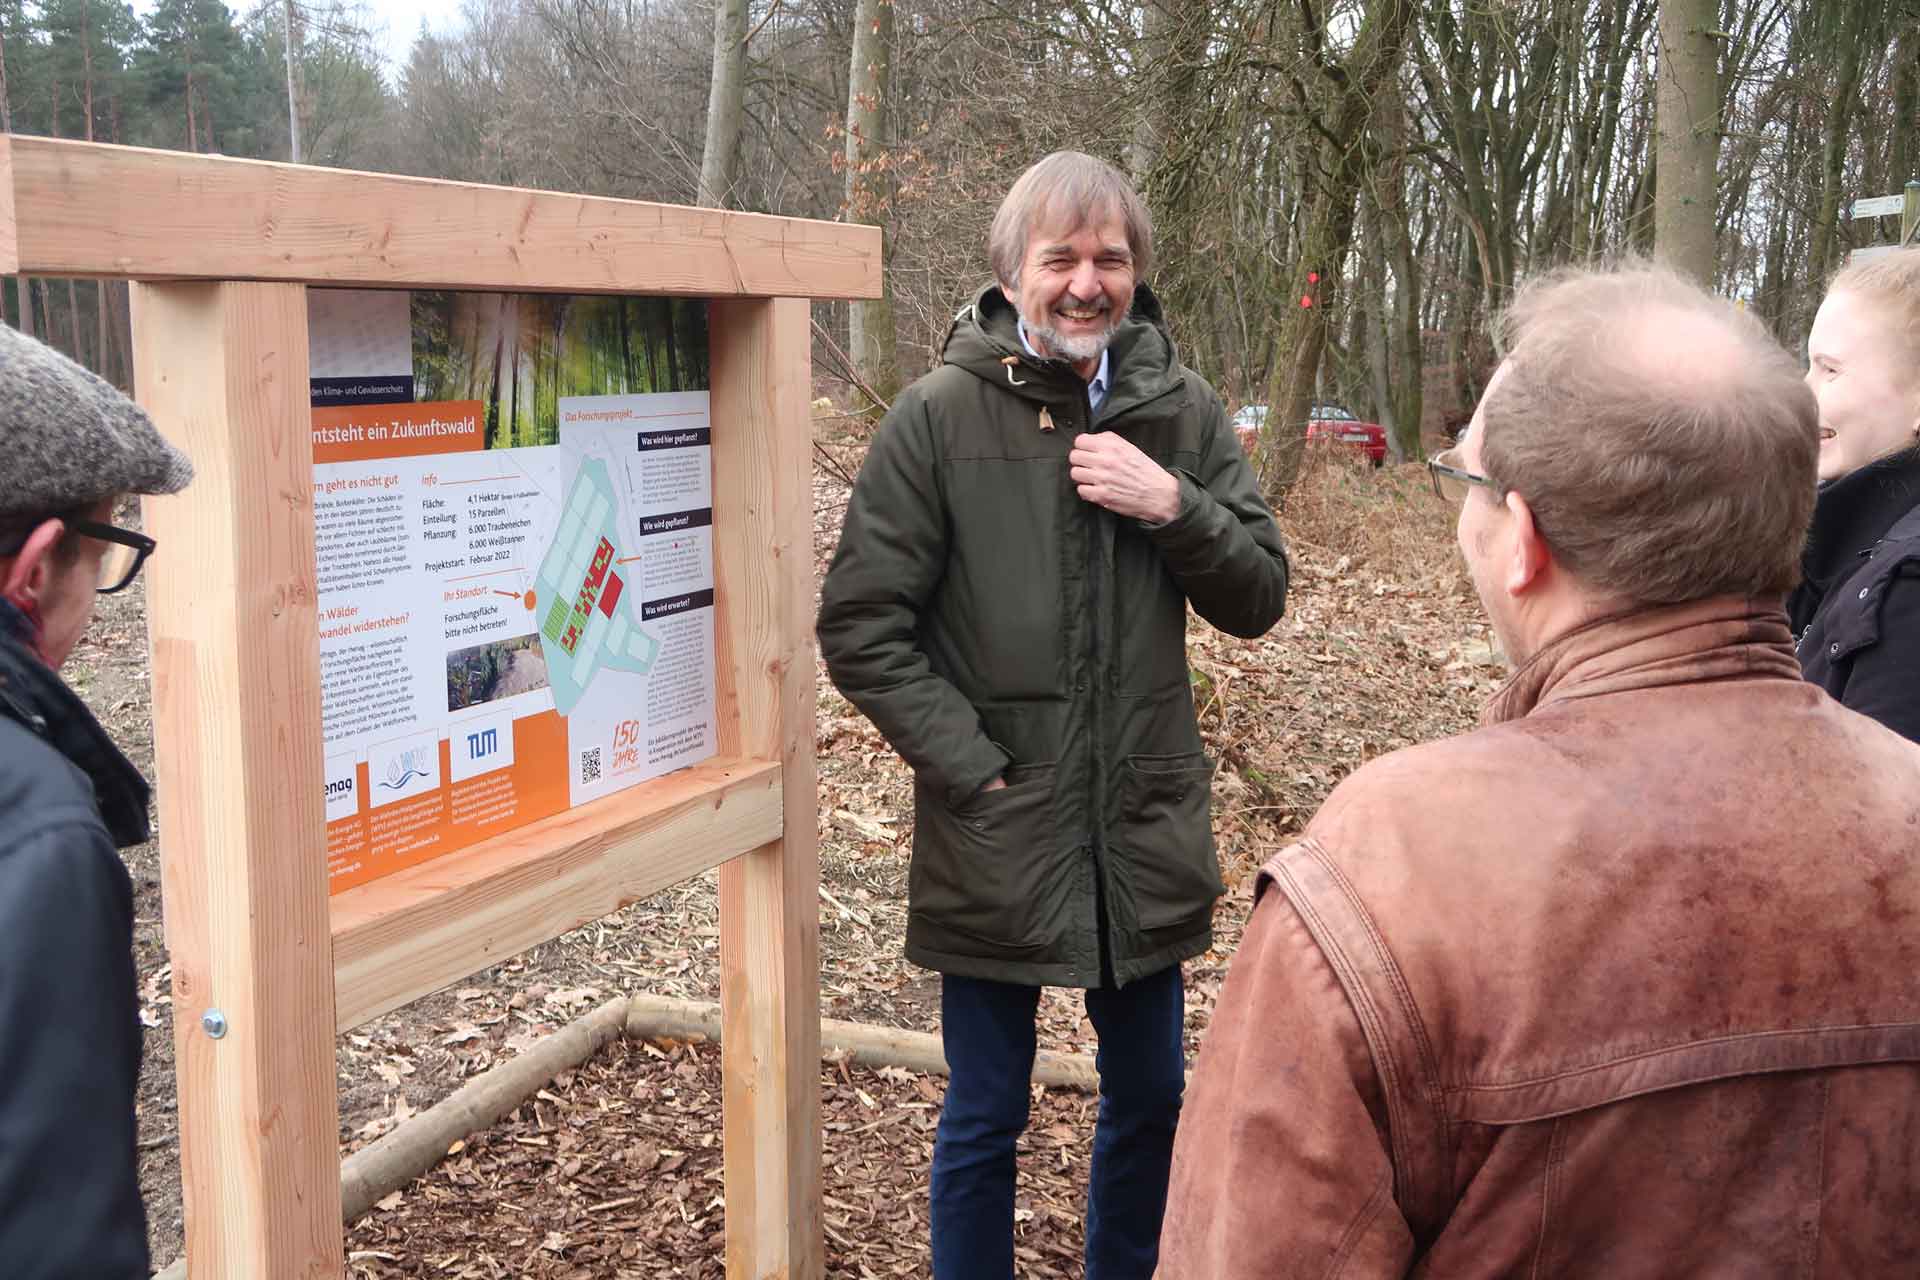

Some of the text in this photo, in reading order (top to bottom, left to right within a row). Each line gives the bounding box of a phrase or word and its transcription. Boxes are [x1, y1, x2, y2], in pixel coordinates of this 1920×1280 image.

[312, 416, 475, 444] ntsteht ein Zukunftswald
[641, 437, 653, 446] Was
[653, 436, 664, 444] wird
[326, 479, 346, 494] geht
[348, 480, 358, 489] es
[360, 476, 382, 488] nicht
[384, 475, 399, 488] gut
[422, 472, 438, 487] Info
[479, 492, 500, 503] Hektar
[468, 510, 477, 520] 15
[478, 507, 506, 518] Parzellen
[468, 524, 487, 535] 6.000
[488, 519, 532, 532] Traubeneichen
[643, 522, 654, 531] Wie
[654, 520, 664, 529] wird
[488, 535, 526, 547] Weißtannen
[470, 554, 494, 565] Februar
[494, 550, 511, 561] 2022
[444, 586, 488, 602] Ihr Standort
[326, 606, 359, 620] Wälder
[645, 598, 690, 616] Was wird erwartet?
[444, 606, 499, 624] Forschungsfläche
[319, 612, 410, 640] wandel widerstehen?
[445, 628, 462, 639] bitte
[462, 624, 479, 634] nicht
[612, 720, 640, 748] 150
[324, 778, 352, 796] enag
